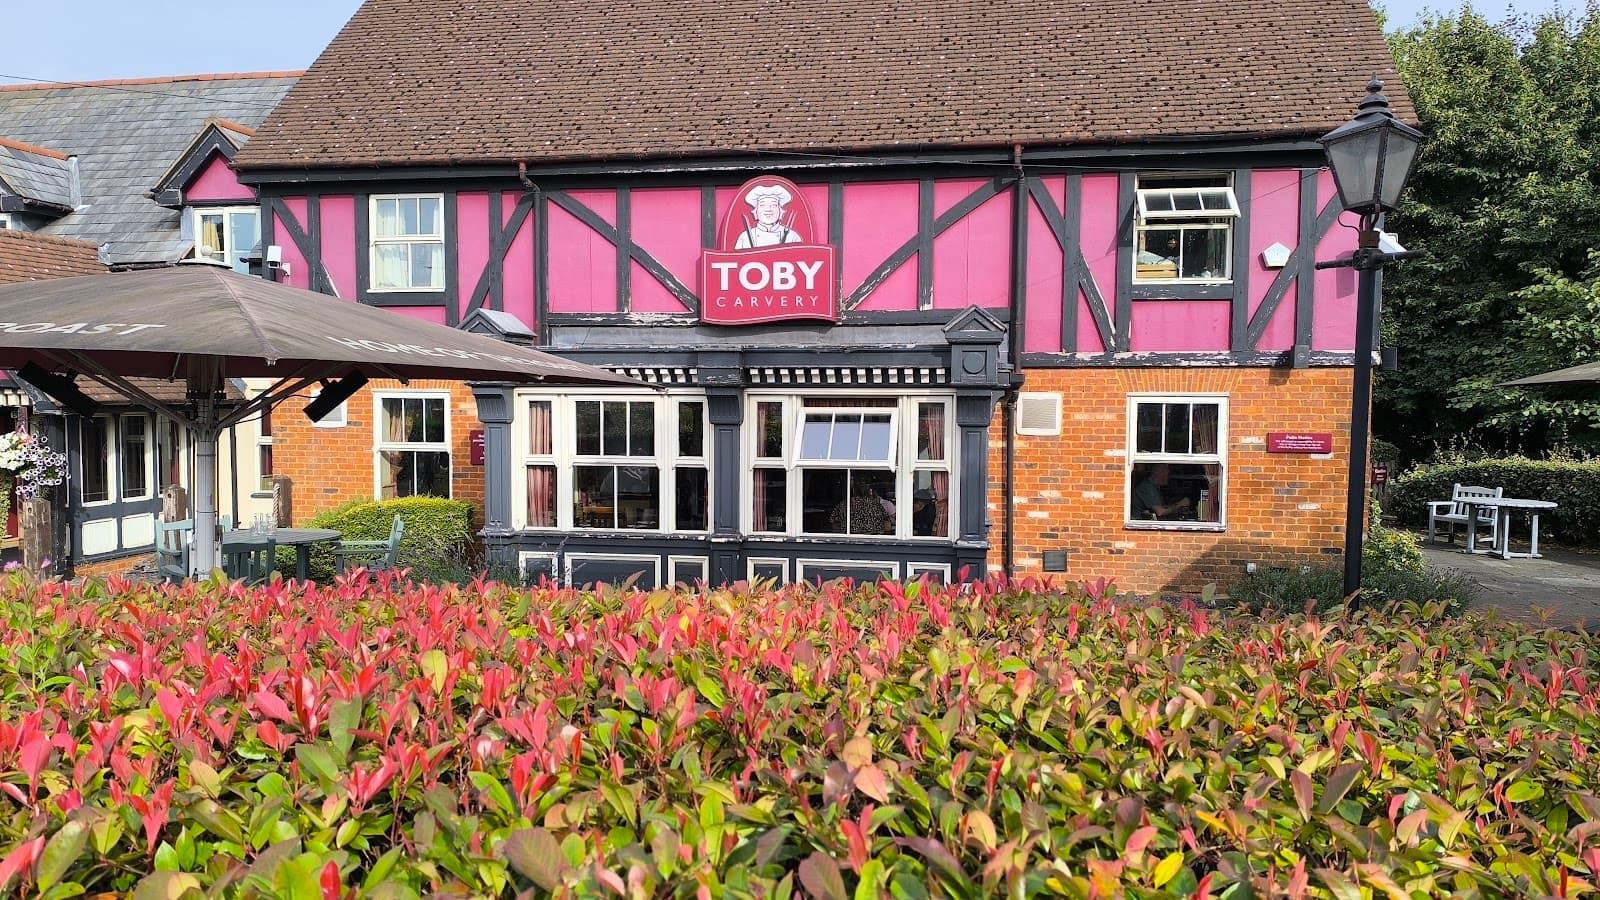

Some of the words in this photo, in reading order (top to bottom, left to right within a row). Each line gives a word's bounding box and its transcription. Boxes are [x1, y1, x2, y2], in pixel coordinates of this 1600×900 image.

[711, 261, 824, 291] TOBY
[716, 296, 818, 307] CARVERY
[325, 336, 446, 357] HOME
